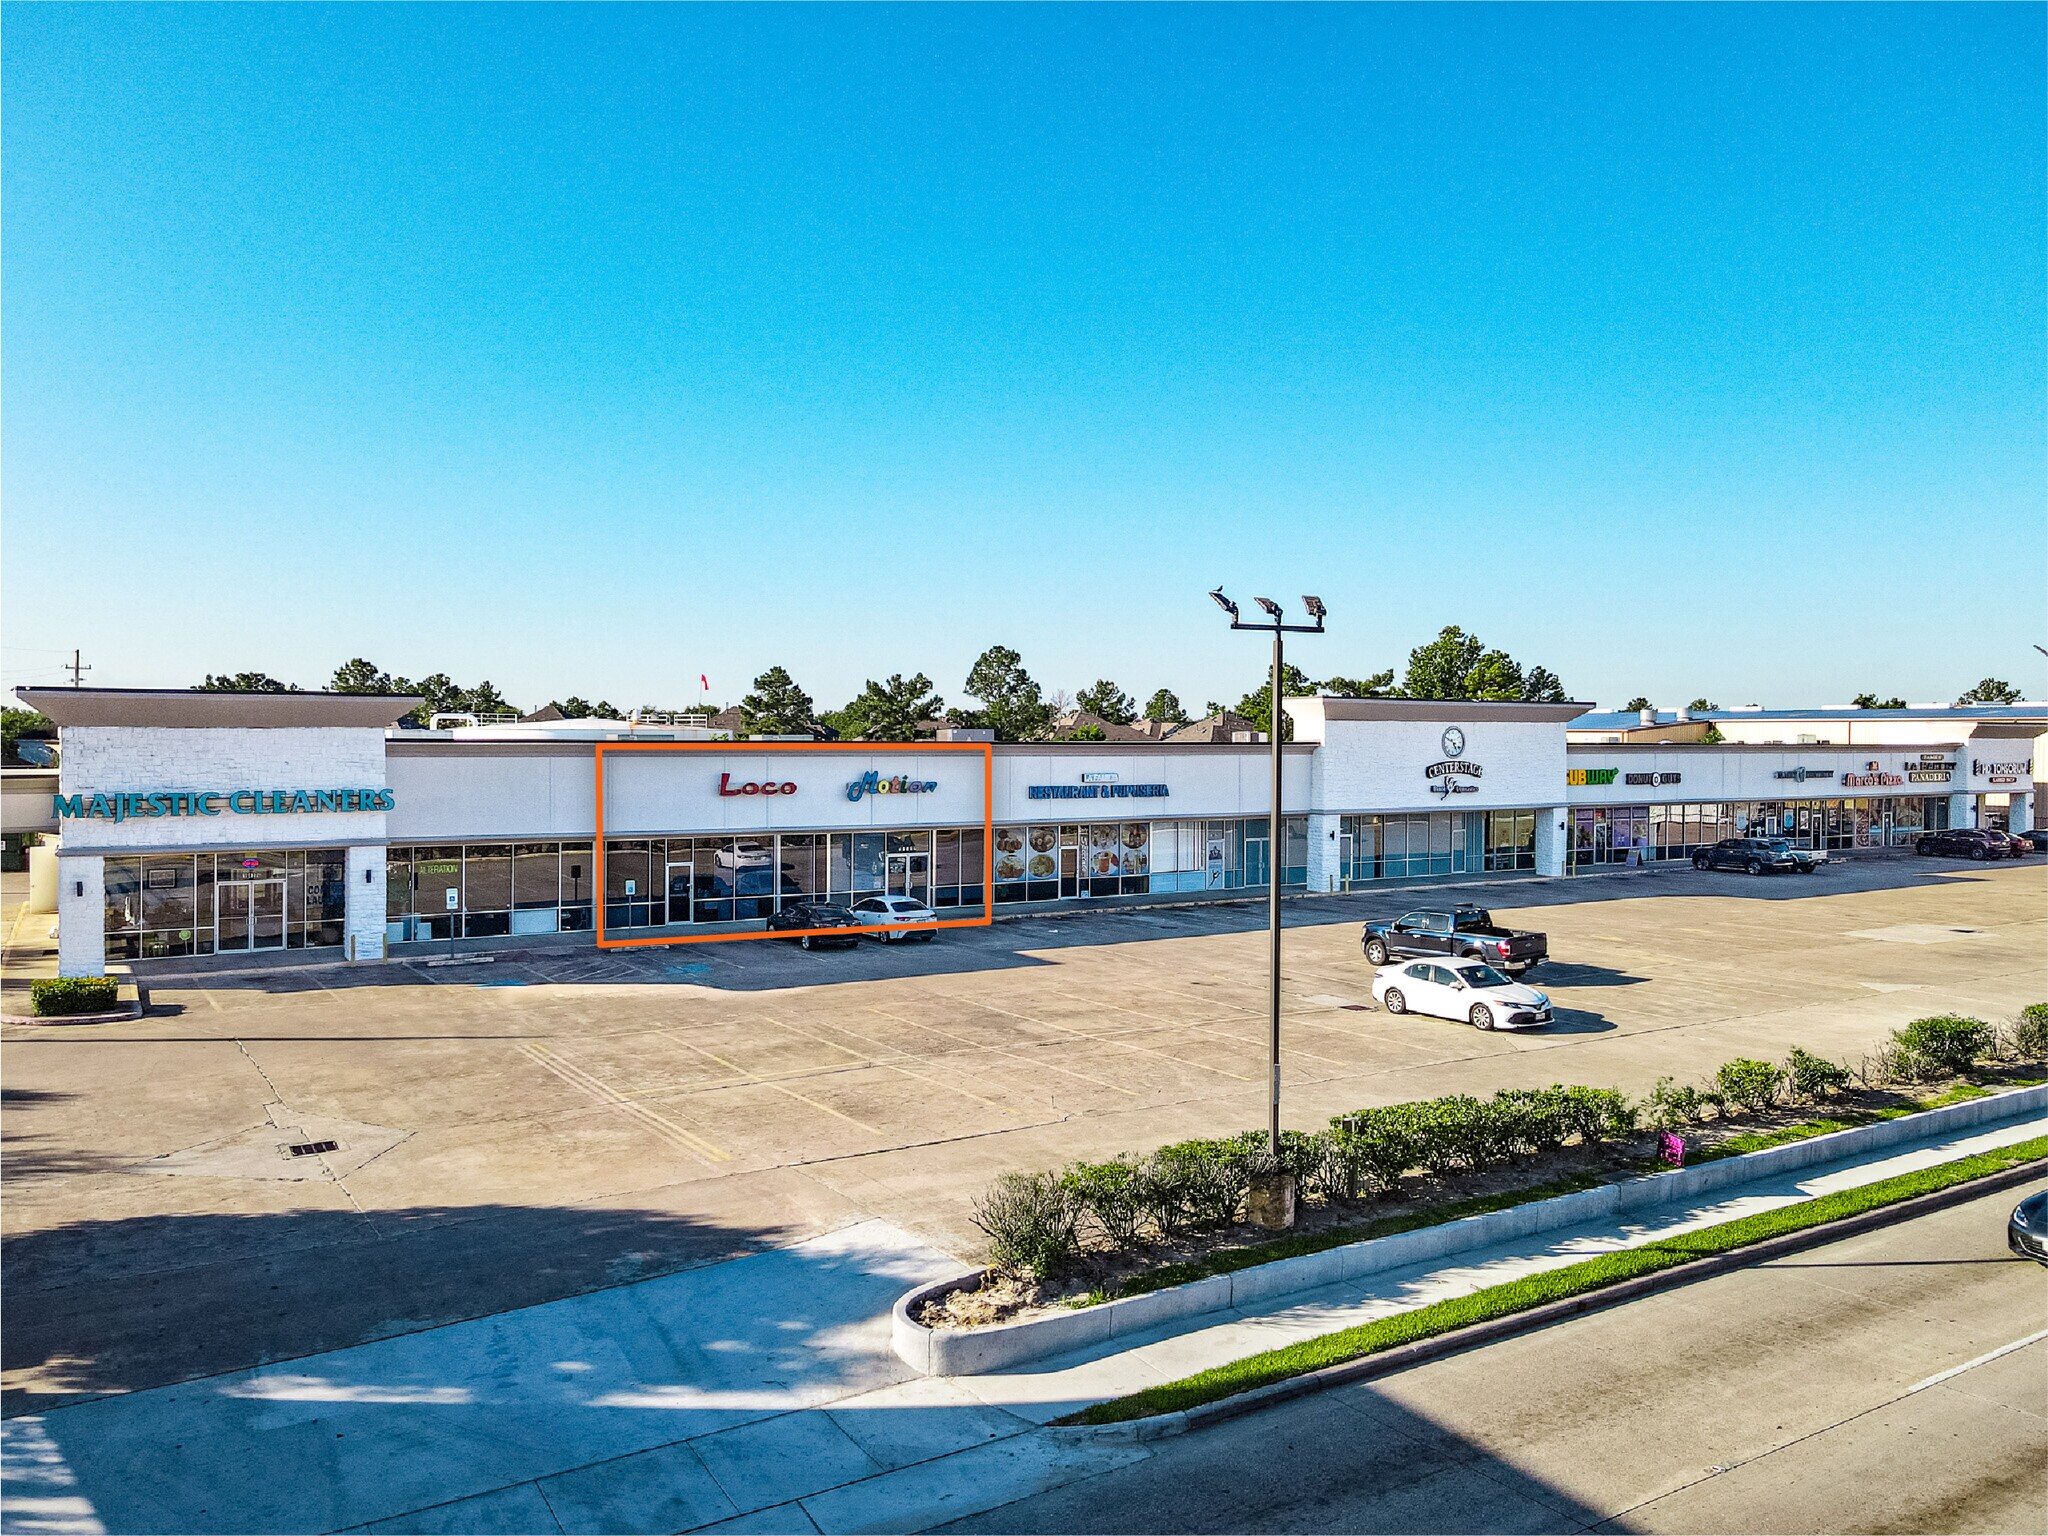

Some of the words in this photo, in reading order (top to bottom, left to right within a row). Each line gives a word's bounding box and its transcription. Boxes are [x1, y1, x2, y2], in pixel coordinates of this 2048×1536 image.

[1427, 761, 1483, 778] CENTERSTAGE
[1911, 773, 1950, 781] PANADERIA
[718, 773, 798, 796] Loco
[847, 771, 938, 802] Motion
[1029, 786, 1100, 799] RESTAURANT
[1100, 785, 1110, 798] &
[1110, 784, 1170, 797] PUPUSERIA
[51, 791, 221, 824] MAJESTIC
[229, 788, 396, 814] CLEANERS
[420, 864, 458, 874] ALTERATION
